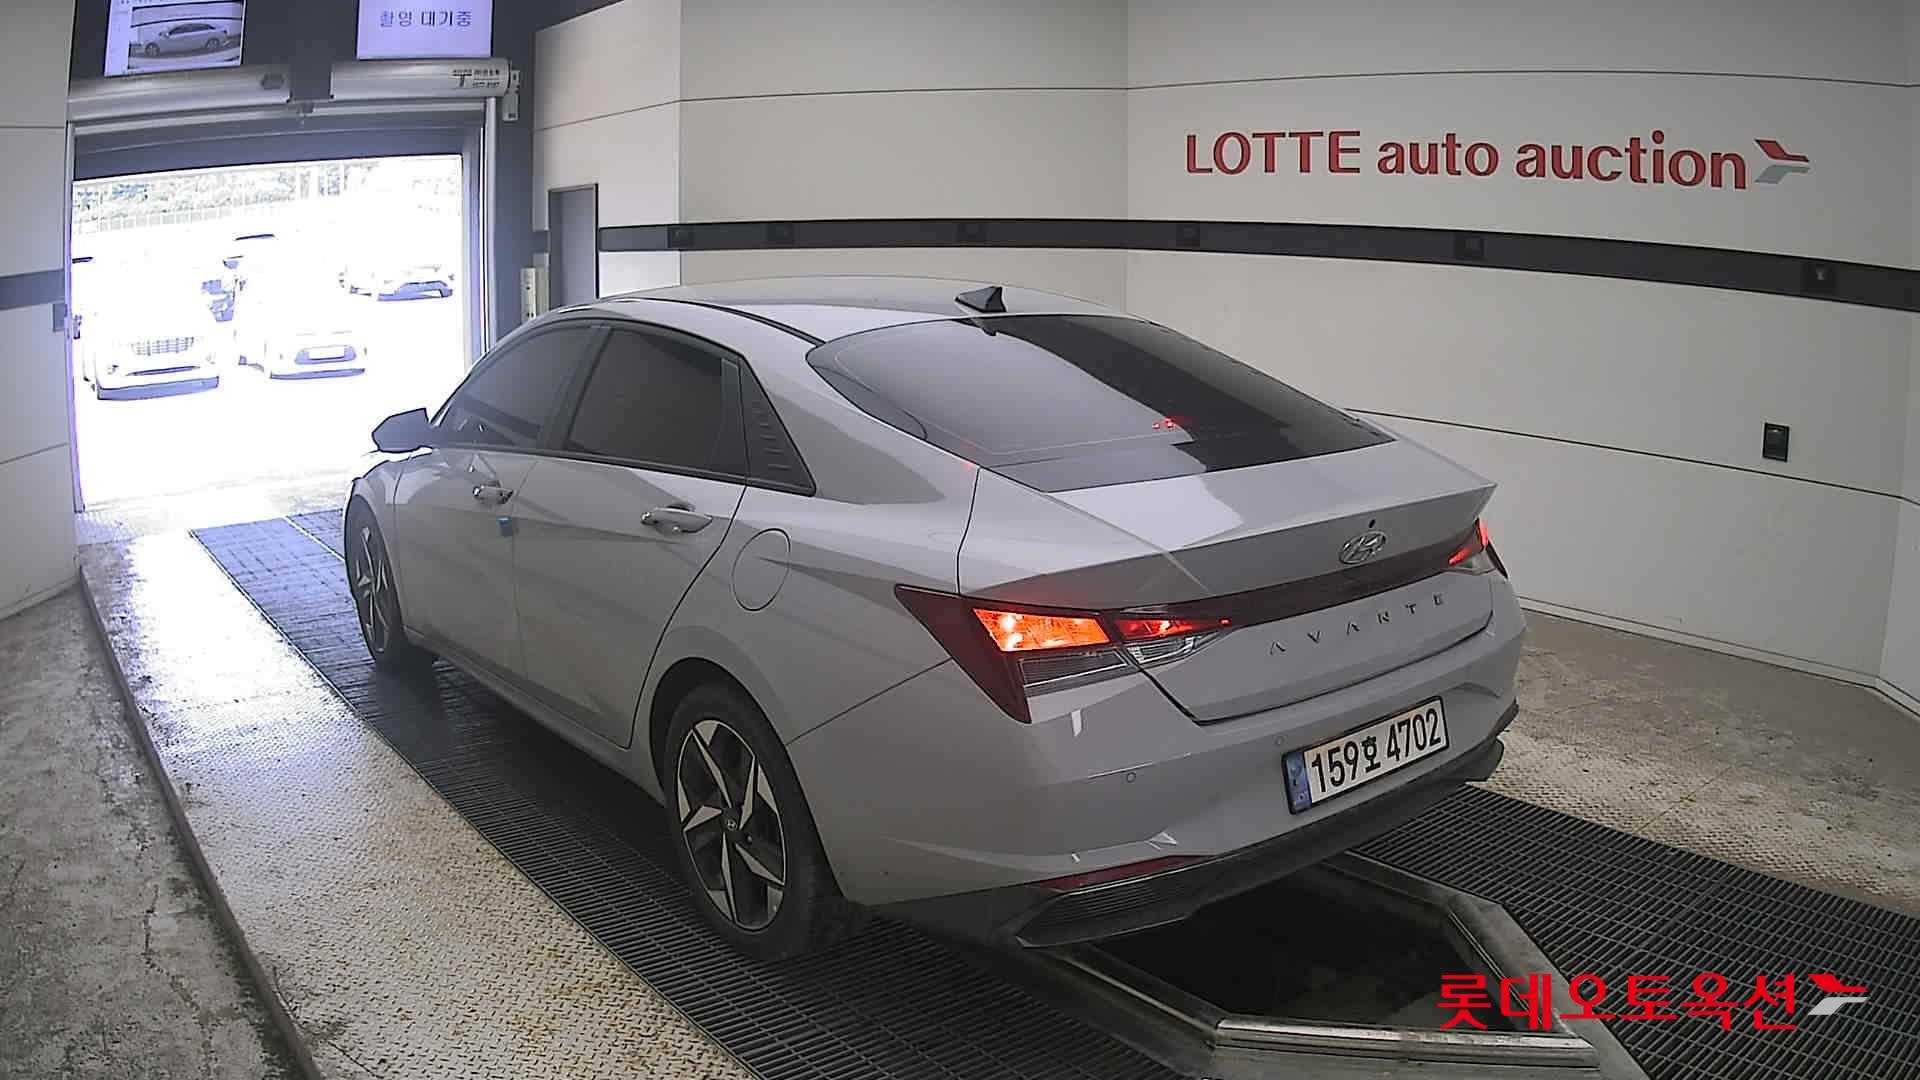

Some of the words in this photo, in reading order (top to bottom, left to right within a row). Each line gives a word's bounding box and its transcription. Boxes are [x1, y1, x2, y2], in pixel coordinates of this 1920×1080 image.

[420, 10, 472, 28] 대기중
[1186, 131, 1361, 174] LOTTE
[1377, 133, 1498, 176] auto
[1516, 131, 1746, 189] auction
[1269, 593, 1444, 655] AVANTE
[1312, 736, 1381, 793] 159호
[1387, 708, 1441, 762] 4702
